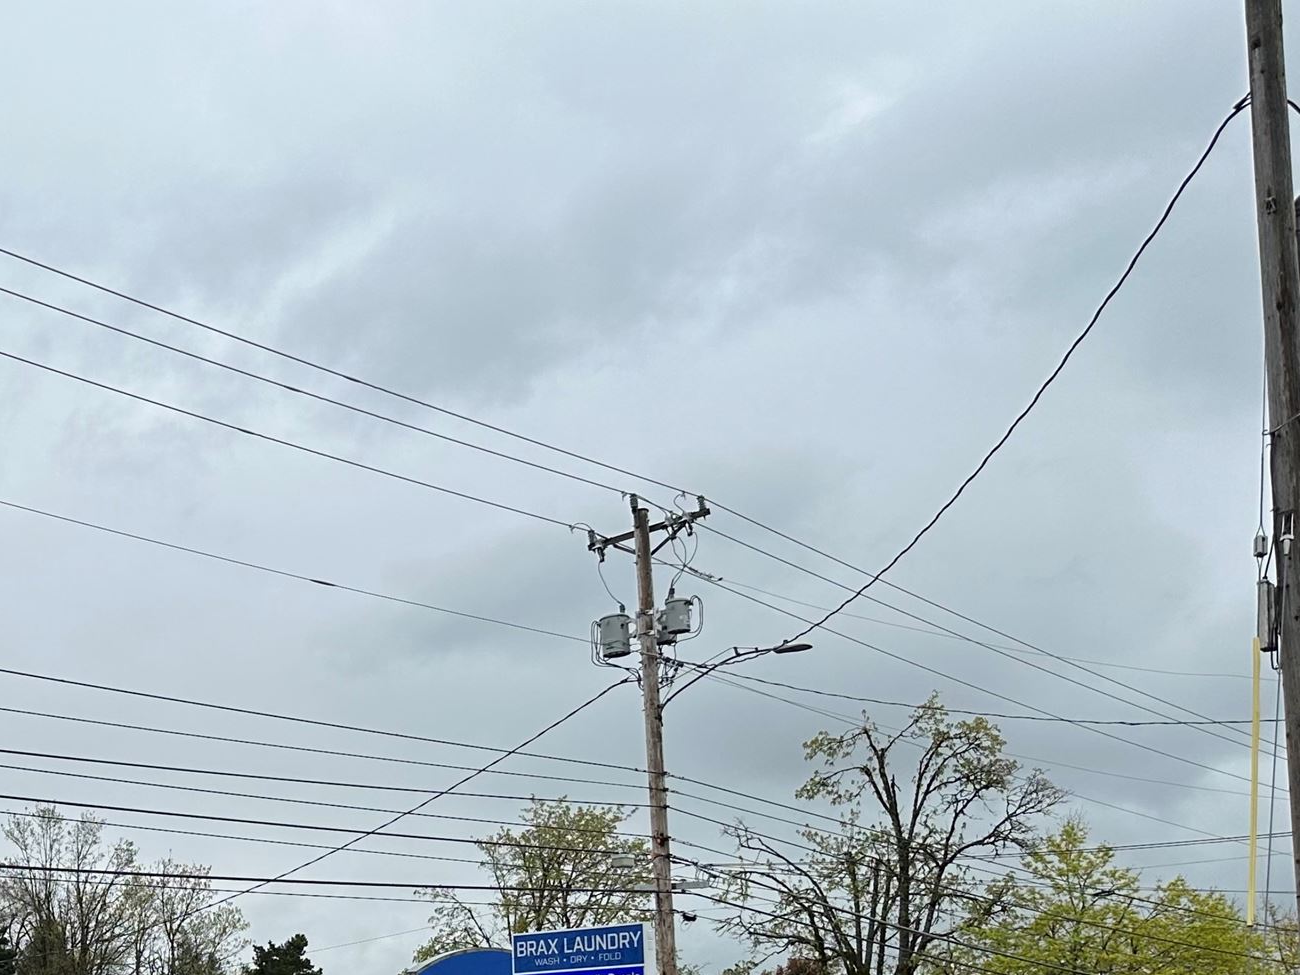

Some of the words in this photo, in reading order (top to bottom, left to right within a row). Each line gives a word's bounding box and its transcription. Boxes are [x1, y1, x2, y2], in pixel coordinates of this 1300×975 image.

[516, 938, 559, 957] BRAX
[563, 931, 641, 953] LAUNDRY
[534, 957, 560, 966] WASH
[570, 955, 588, 964] DRY
[598, 952, 622, 961] FOLD
